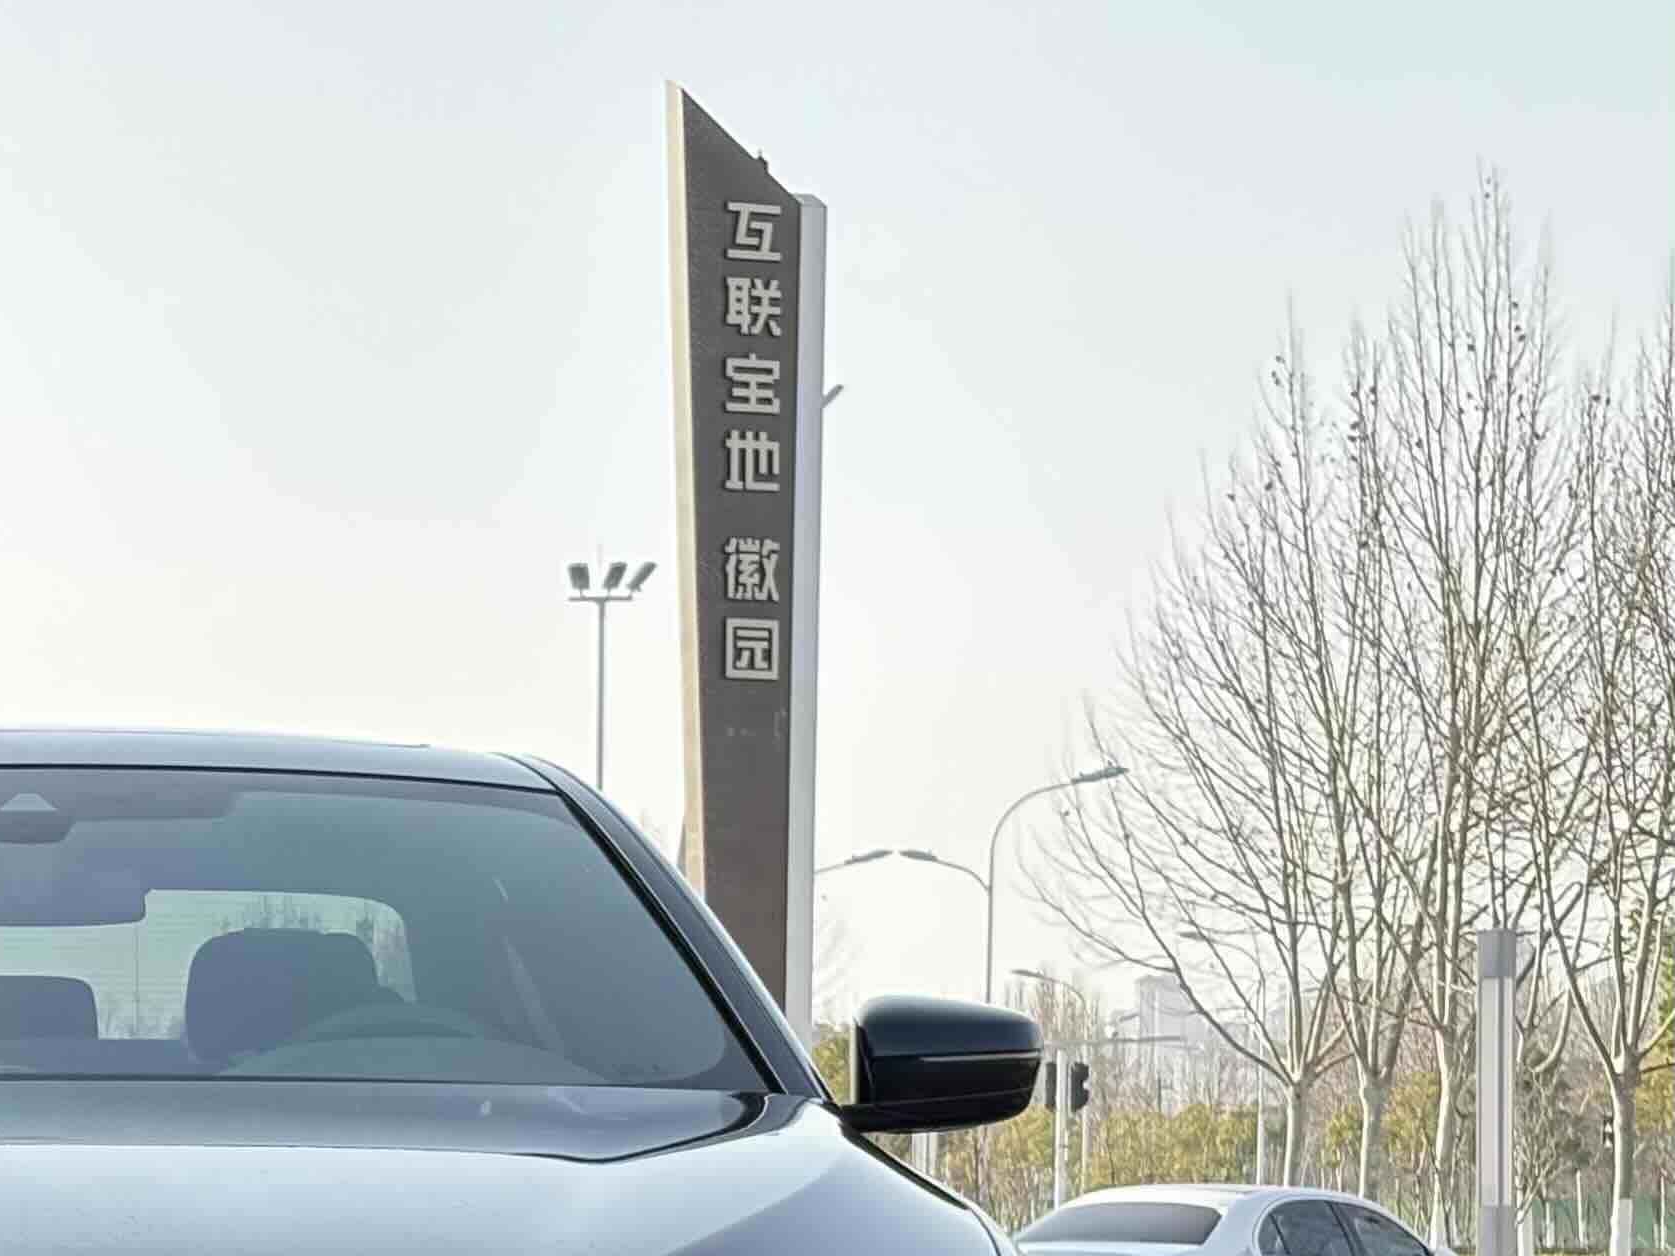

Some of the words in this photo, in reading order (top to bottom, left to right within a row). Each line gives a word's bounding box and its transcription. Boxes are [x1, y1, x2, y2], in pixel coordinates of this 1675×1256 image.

[724, 201, 782, 492] 互联宝地
[724, 536, 781, 681] 徽园
